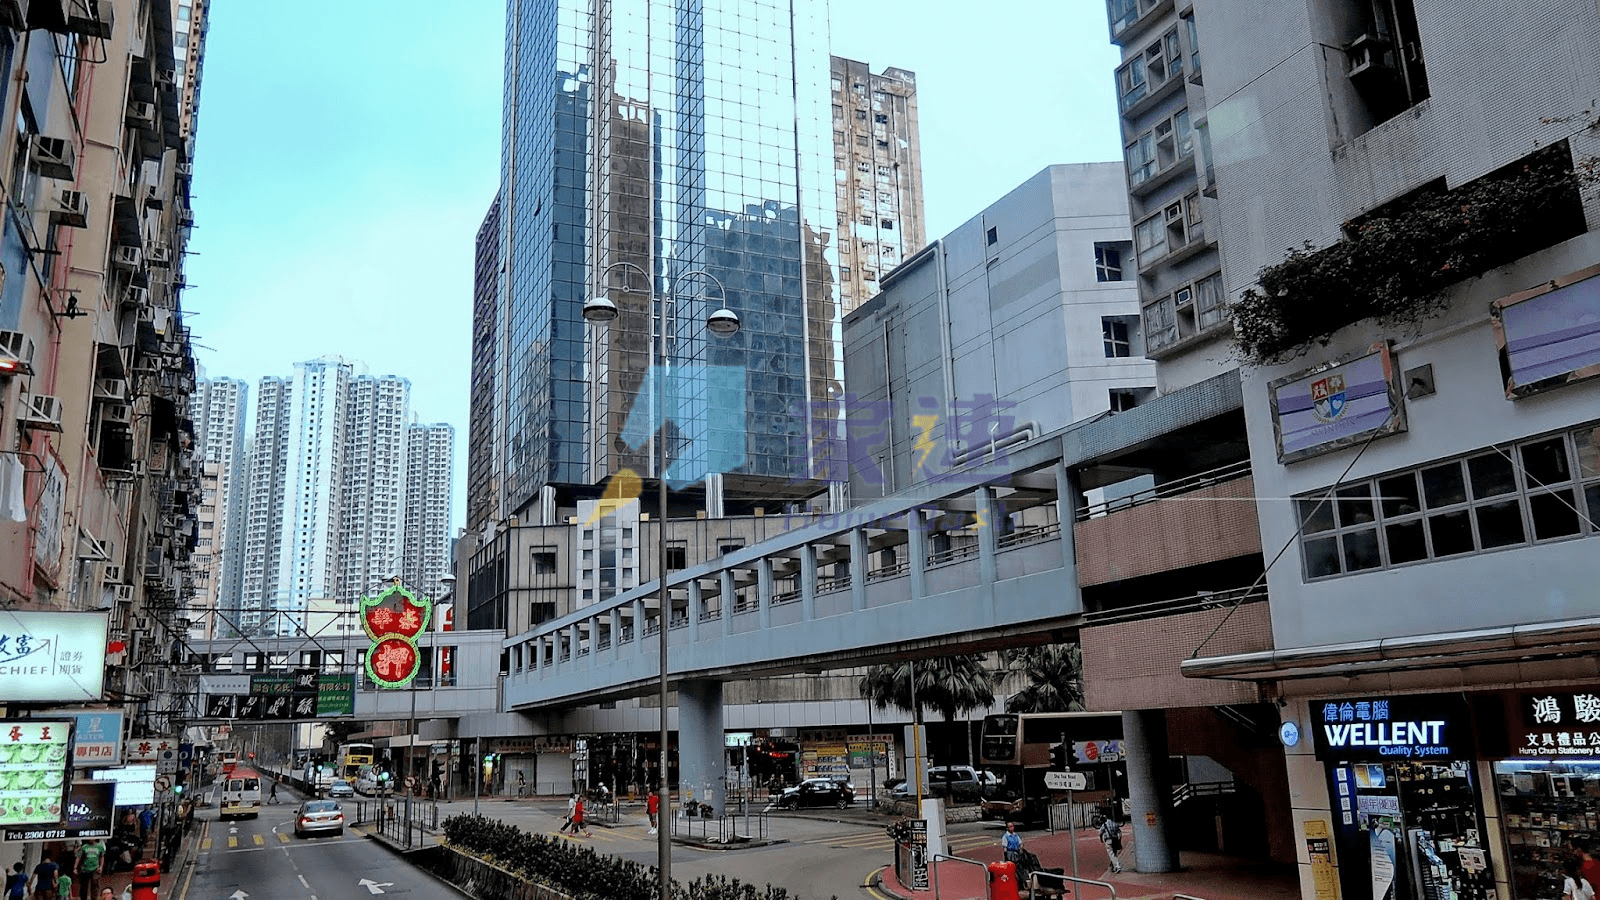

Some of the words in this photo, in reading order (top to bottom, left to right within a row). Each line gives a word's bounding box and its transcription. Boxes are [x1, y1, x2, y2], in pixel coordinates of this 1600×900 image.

[60, 651, 83, 661] 證券
[376, 644, 410, 679] 押
[59, 665, 83, 675] 期貨
[1322, 700, 1389, 722] 偉倫電腦
[1324, 721, 1445, 746] WELLENT
[75, 746, 112, 757] 專門店
[1379, 745, 1412, 757] Quality
[1414, 745, 1449, 757] System
[1518, 747, 1538, 756] Hung
[1538, 746, 1557, 755] Chun
[1557, 746, 1594, 756] Stationery
